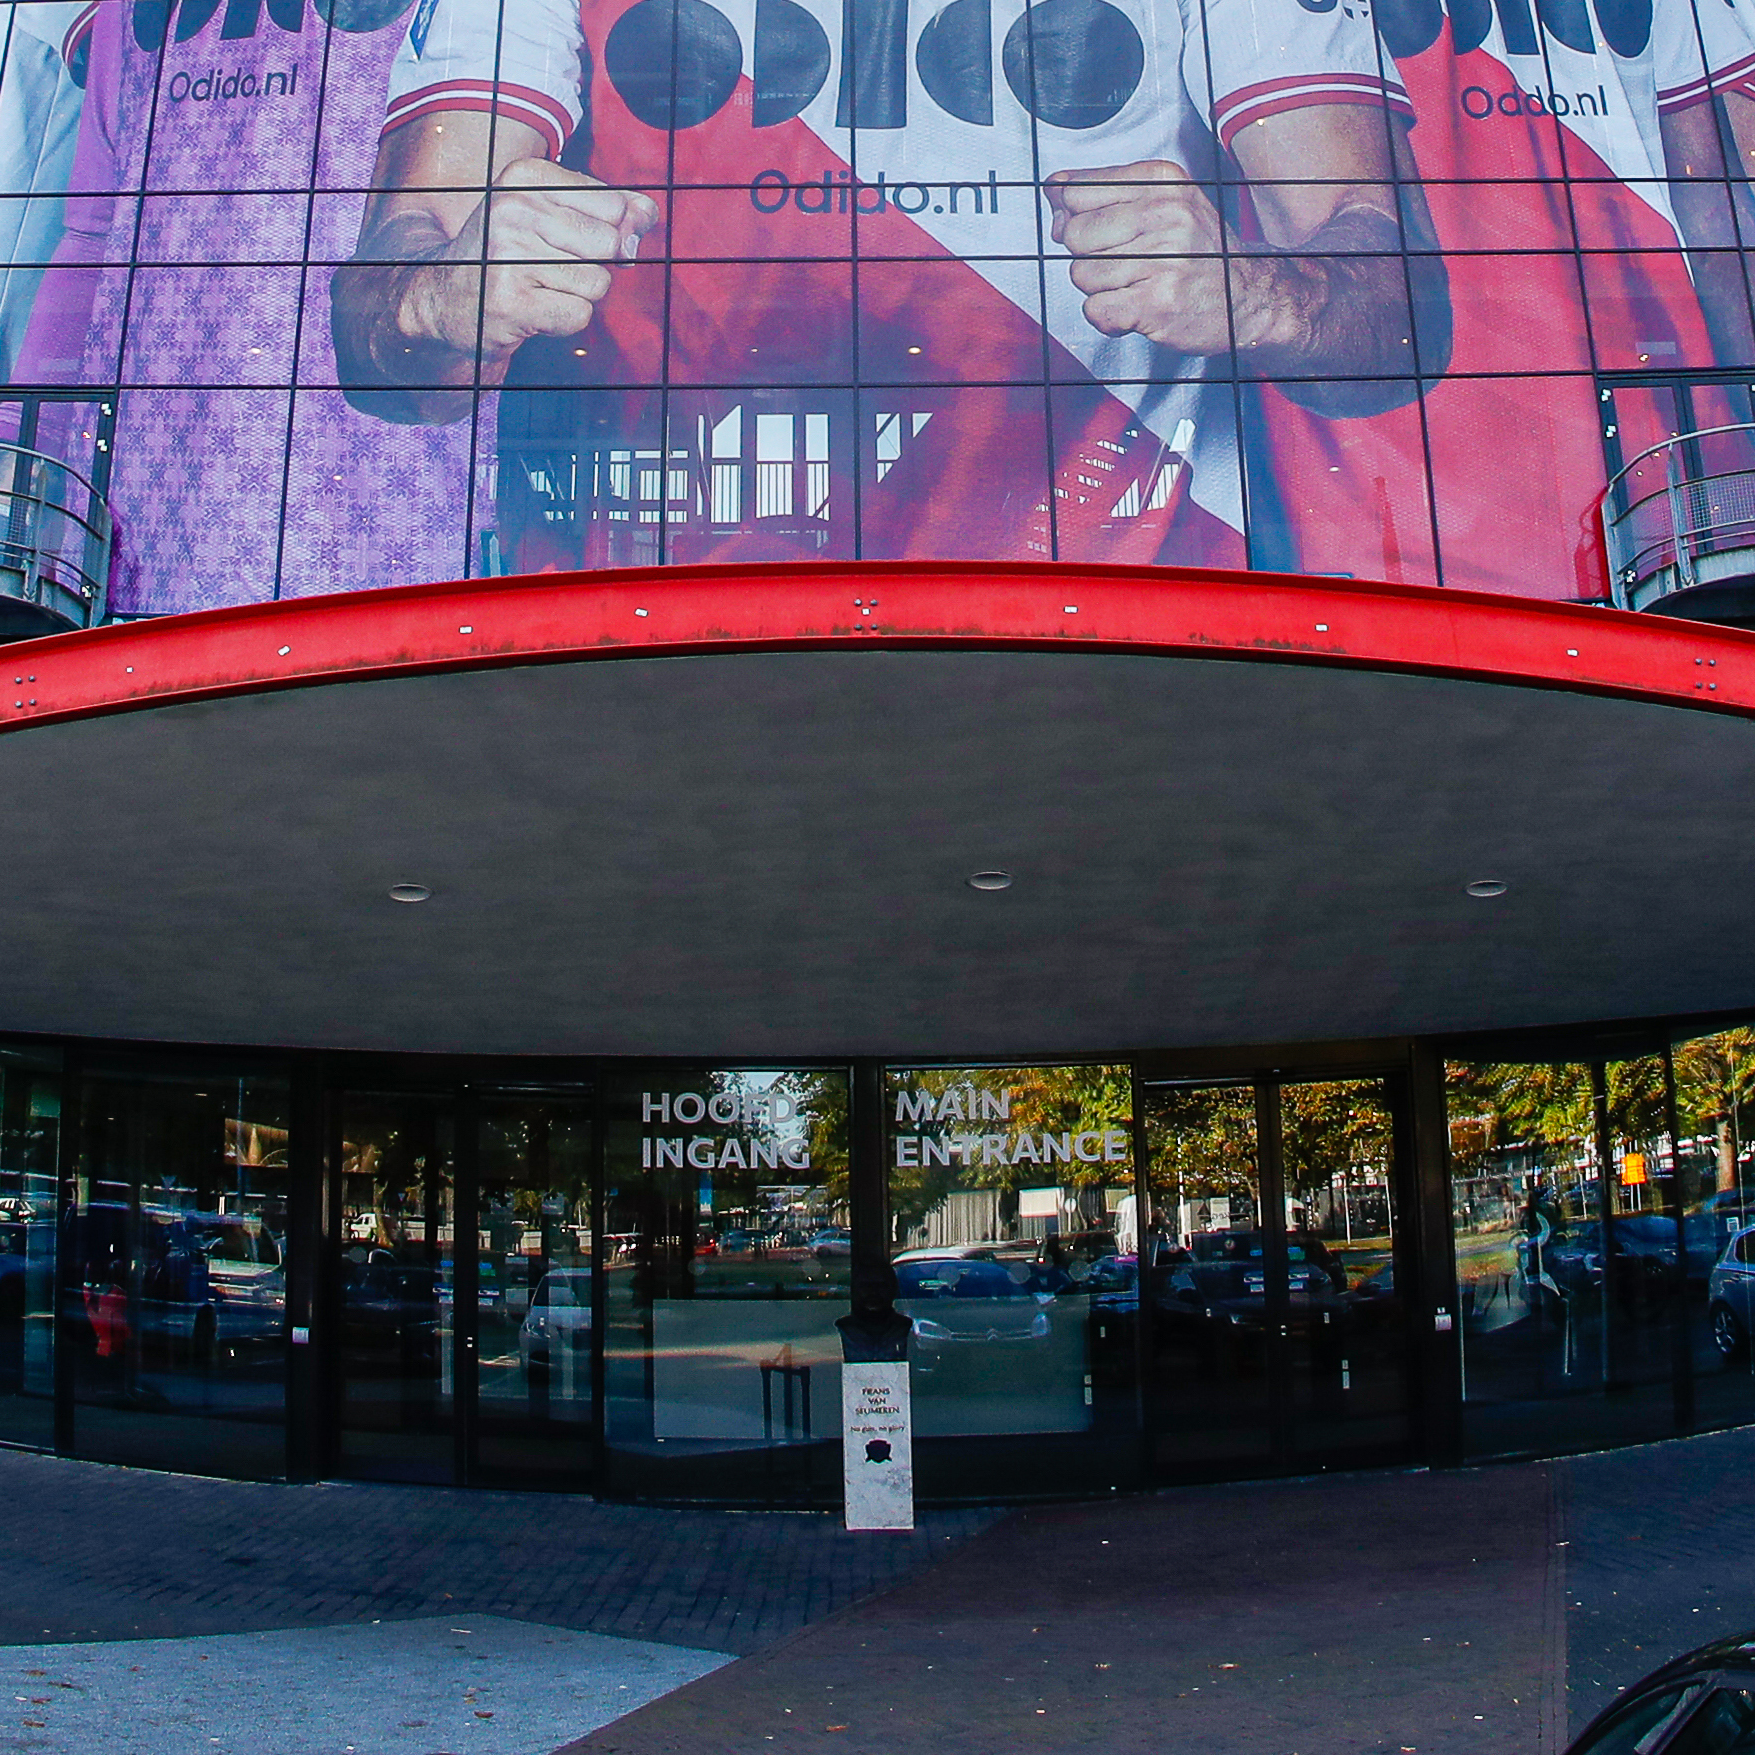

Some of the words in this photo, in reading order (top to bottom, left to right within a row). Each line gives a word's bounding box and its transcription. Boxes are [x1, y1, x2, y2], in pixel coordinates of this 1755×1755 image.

[169, 63, 298, 103] Odido.nl
[750, 170, 1000, 216] Odido.nl
[641, 1092, 797, 1125] HOOFD
[896, 1090, 1011, 1123] MAIN
[642, 1137, 810, 1170] INGANG
[895, 1130, 1127, 1168] ENTRANCE
